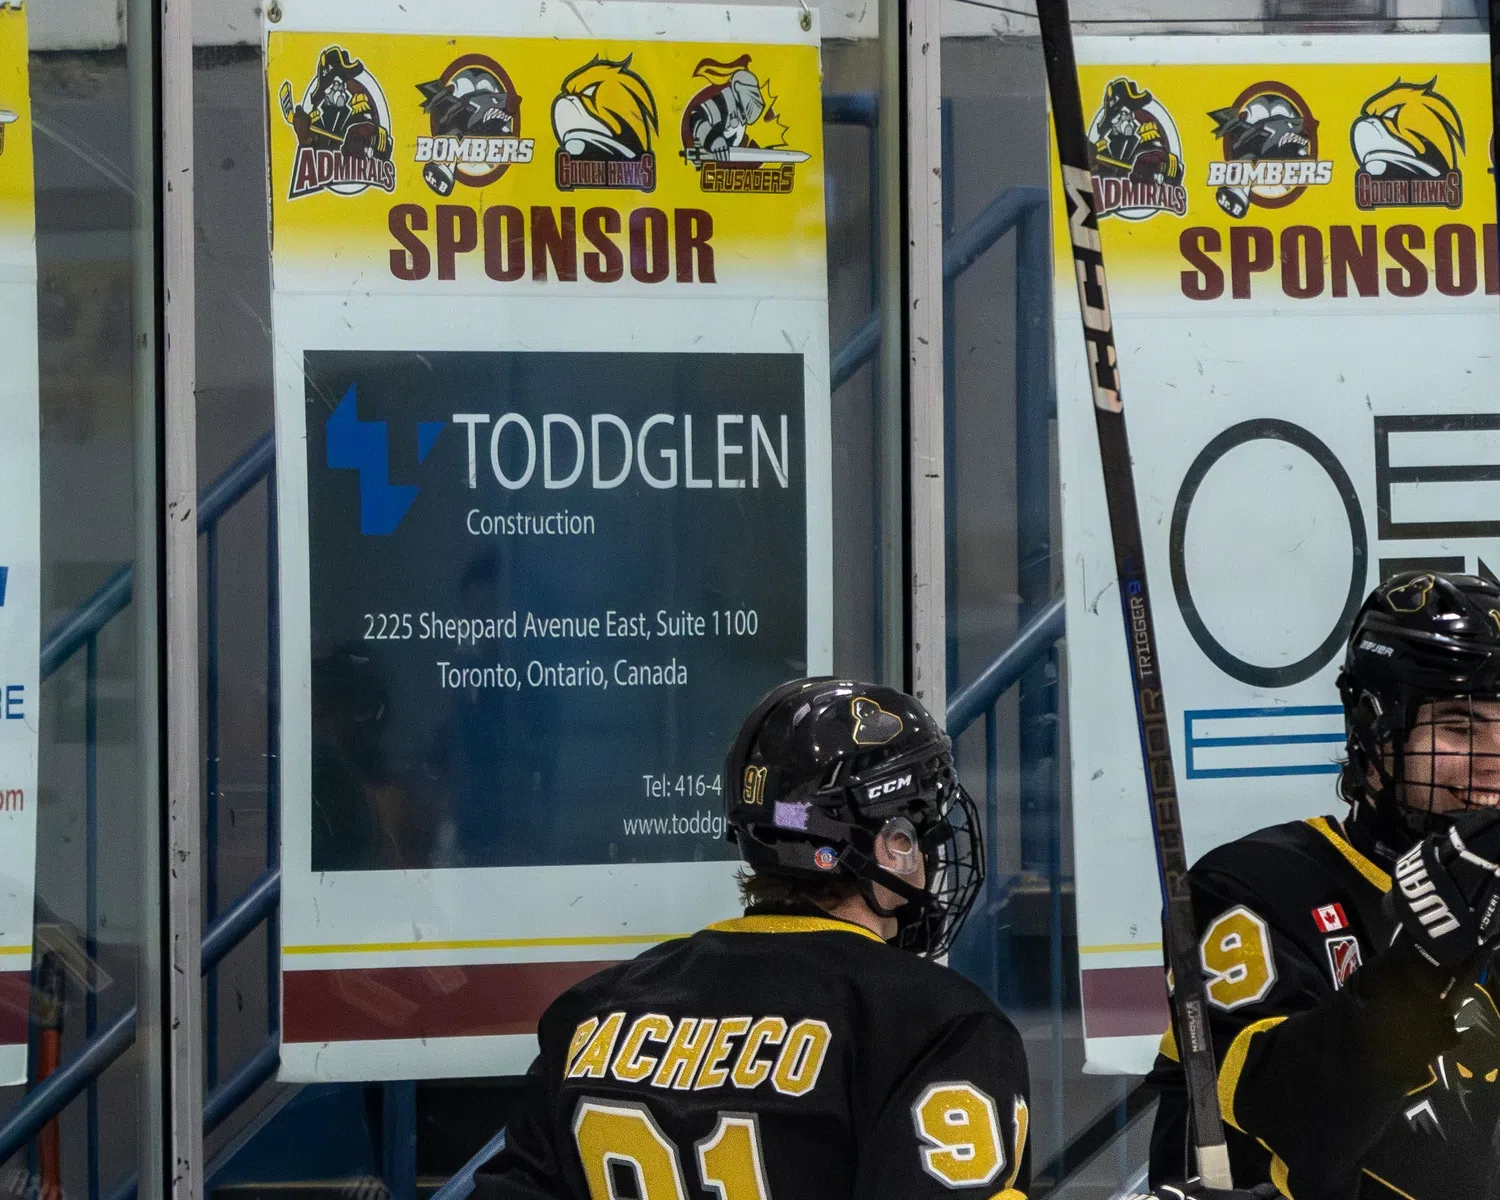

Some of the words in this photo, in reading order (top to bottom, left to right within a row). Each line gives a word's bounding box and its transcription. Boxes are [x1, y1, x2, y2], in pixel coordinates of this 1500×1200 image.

[415, 138, 534, 163] BOMBERS
[295, 148, 395, 191] ADMIRALS
[701, 163, 795, 193] CRUSADERS
[1207, 161, 1333, 186] BOMBERS
[388, 203, 717, 284] SPONSOR
[1061, 163, 1124, 414] CCM
[452, 412, 789, 489] TODDGLEN
[467, 508, 595, 536] Construction
[363, 612, 413, 640] 2225
[419, 611, 517, 645] Sheppard
[524, 611, 600, 638] Avenue
[605, 610, 652, 640] East,
[656, 609, 705, 637] Suite
[711, 609, 758, 636] 1100
[1130, 597, 1154, 680] TRIGGER
[437, 661, 521, 692] Toronto,
[527, 659, 608, 689] Ontario,
[614, 658, 688, 686] Canada
[0, 684, 25, 720] E
[643, 774, 671, 797] Tel:
[743, 764, 768, 806] 91
[867, 774, 913, 799] CCM
[564, 1011, 833, 1097] PACHECO
